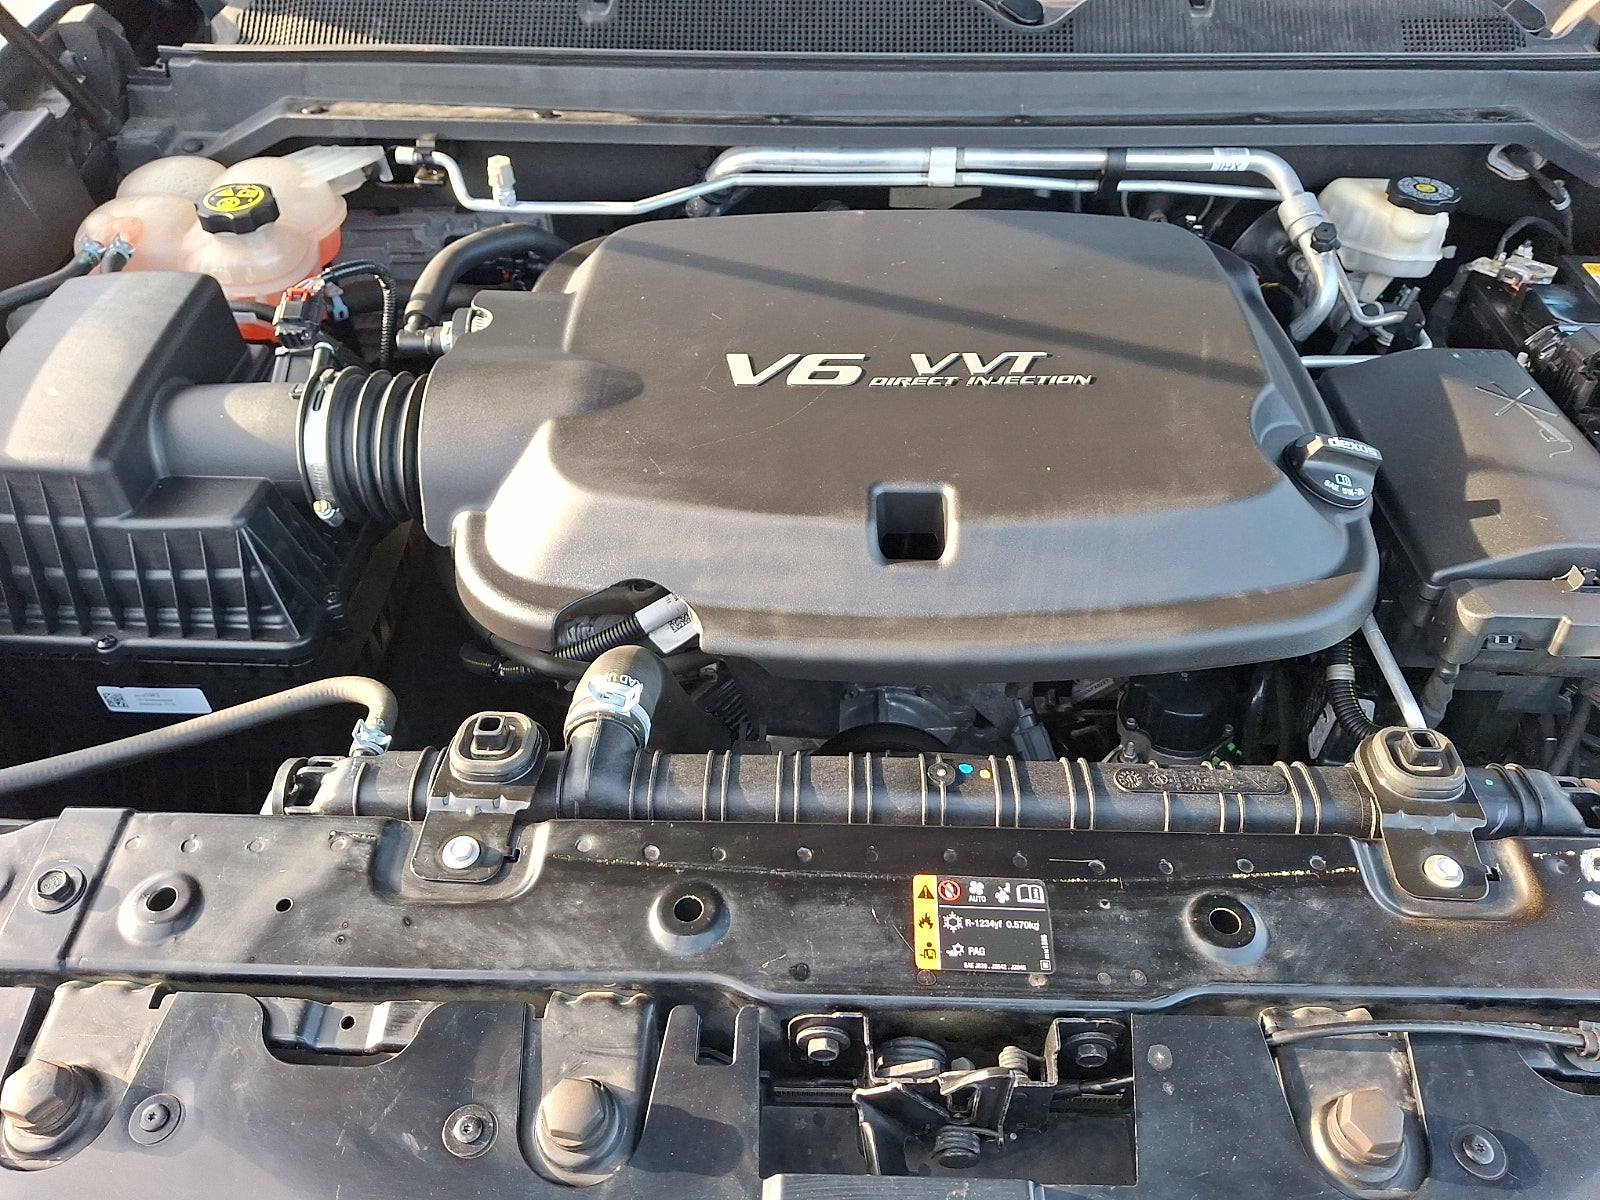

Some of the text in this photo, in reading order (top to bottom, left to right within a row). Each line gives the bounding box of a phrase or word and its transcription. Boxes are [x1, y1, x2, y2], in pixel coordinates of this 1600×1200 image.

[726, 352, 867, 388] V6
[910, 351, 1050, 376] VVT
[868, 375, 1094, 388] DIRECT INJECTION
[1323, 479, 1340, 492] SAE
[968, 895, 987, 903] AUTO
[964, 918, 1040, 931] R-1234yf 0.570kg
[967, 946, 986, 956] PAG
